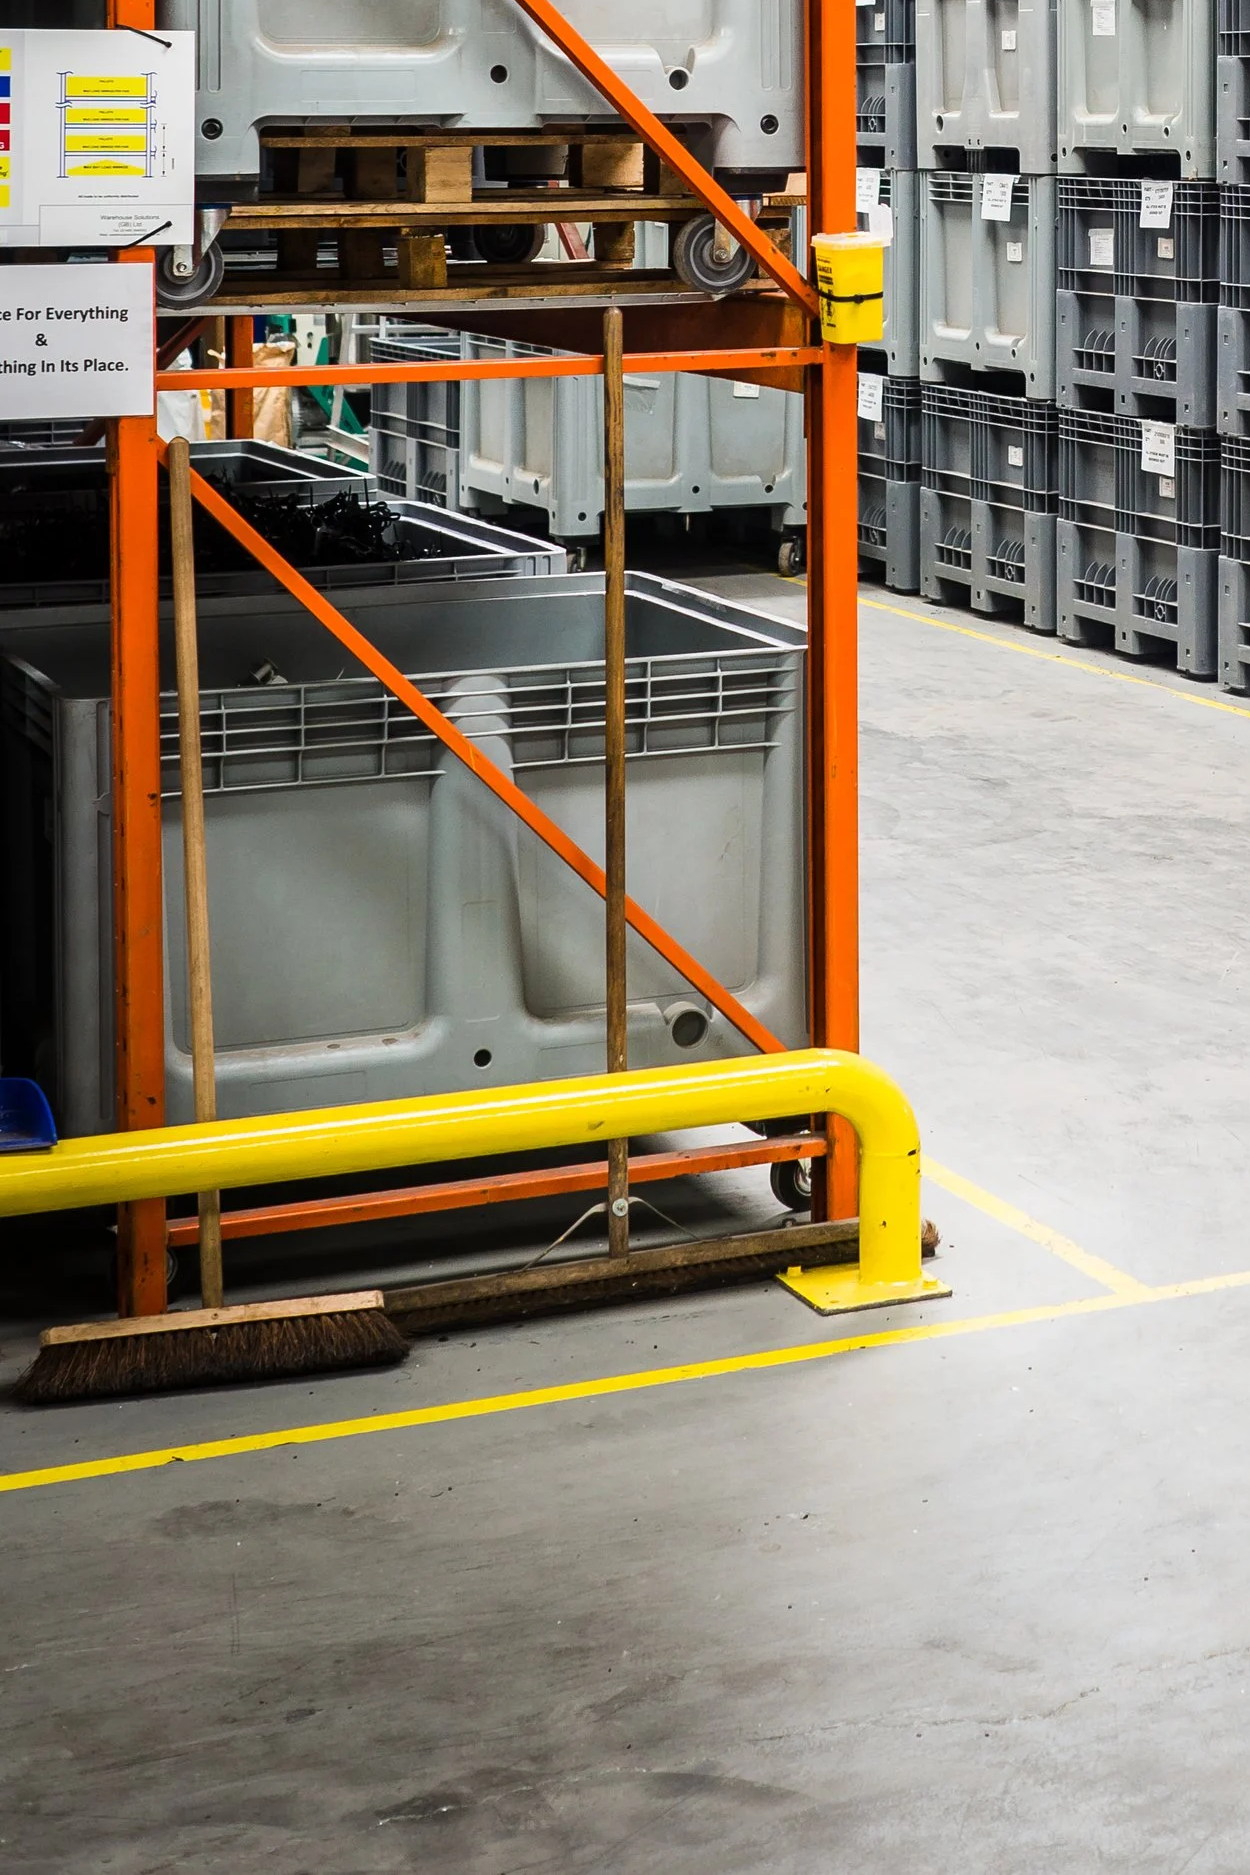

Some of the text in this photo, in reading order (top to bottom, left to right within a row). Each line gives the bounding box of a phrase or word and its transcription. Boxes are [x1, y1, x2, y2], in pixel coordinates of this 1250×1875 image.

[16, 307, 41, 321] For
[46, 306, 129, 323] Everything
[35, 333, 48, 347] &
[41, 360, 56, 373] In
[60, 359, 79, 373] Its
[83, 358, 129, 372] Place.
